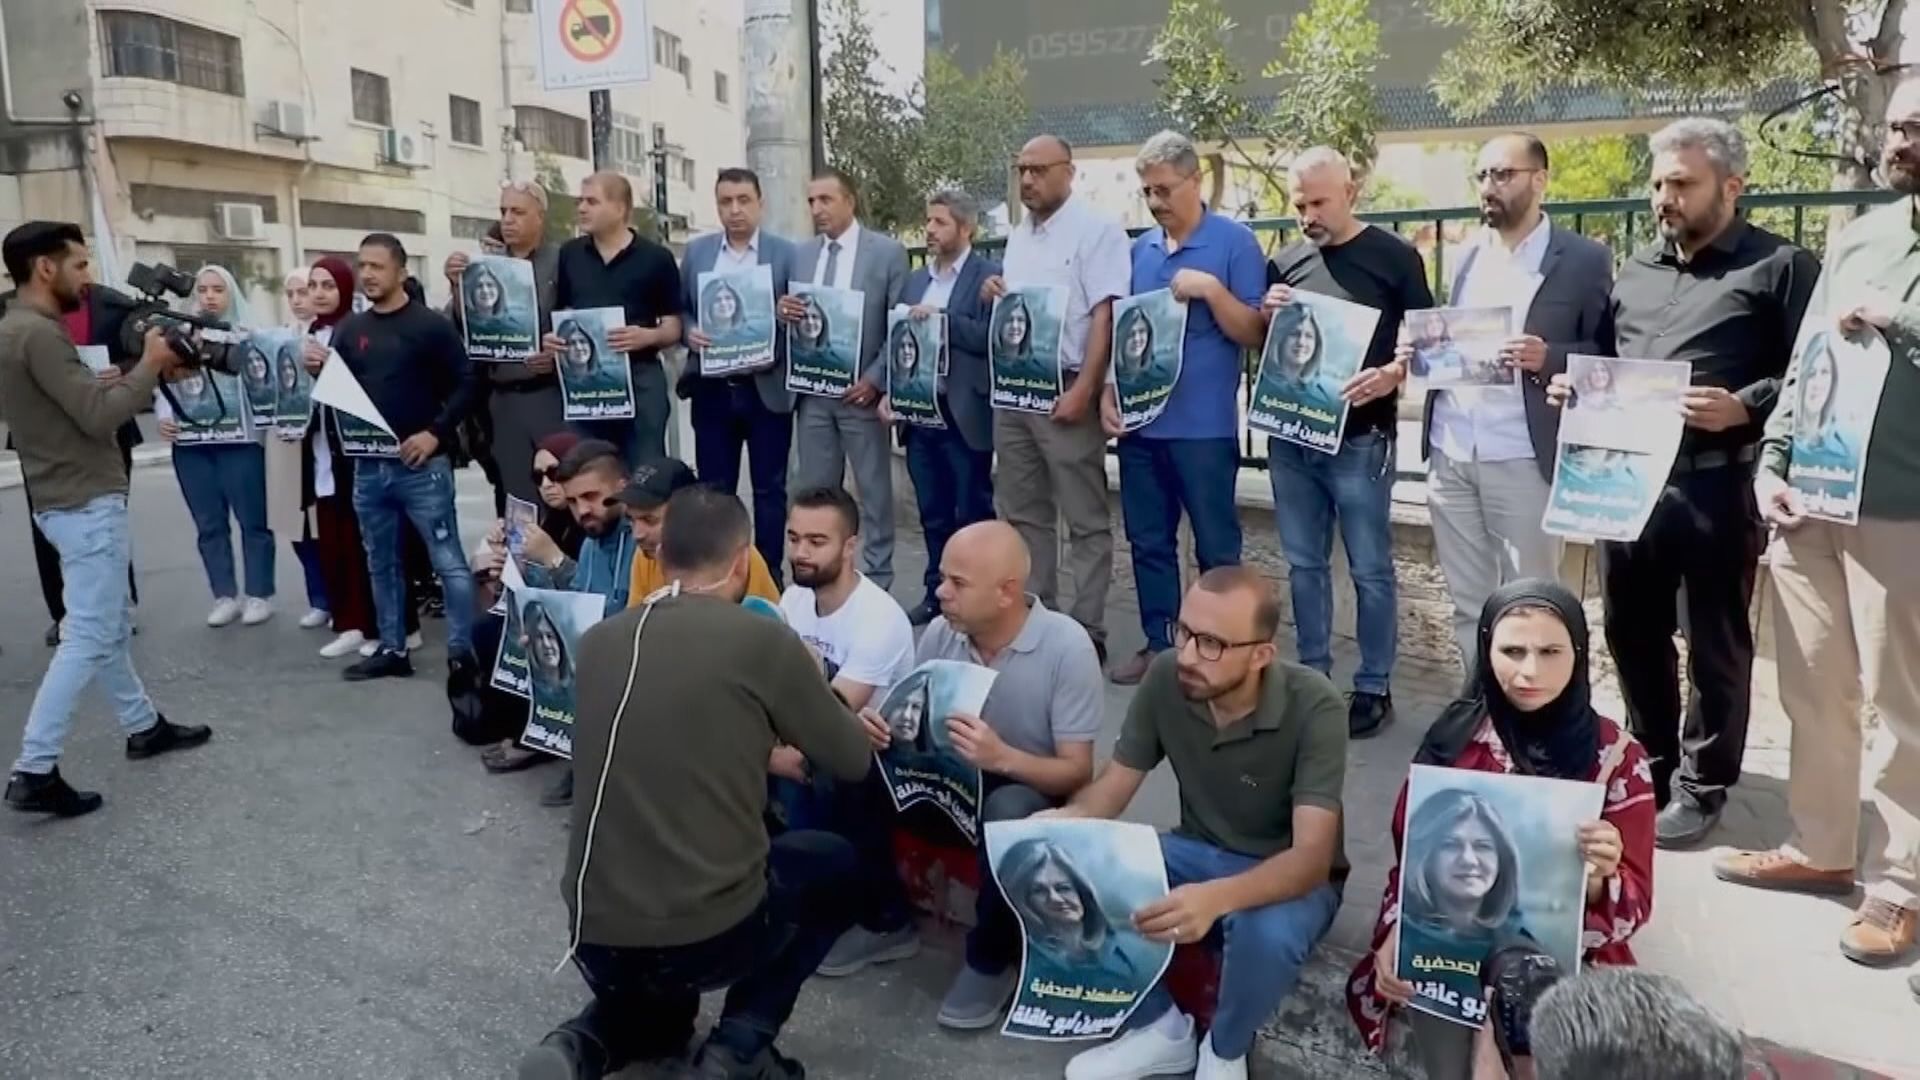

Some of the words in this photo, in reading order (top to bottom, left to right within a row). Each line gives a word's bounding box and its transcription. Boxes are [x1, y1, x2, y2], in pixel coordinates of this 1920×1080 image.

[1411, 954, 1482, 976] لصحفية
[1415, 981, 1460, 1008] عاقل
[1460, 995, 1489, 1021] بو
